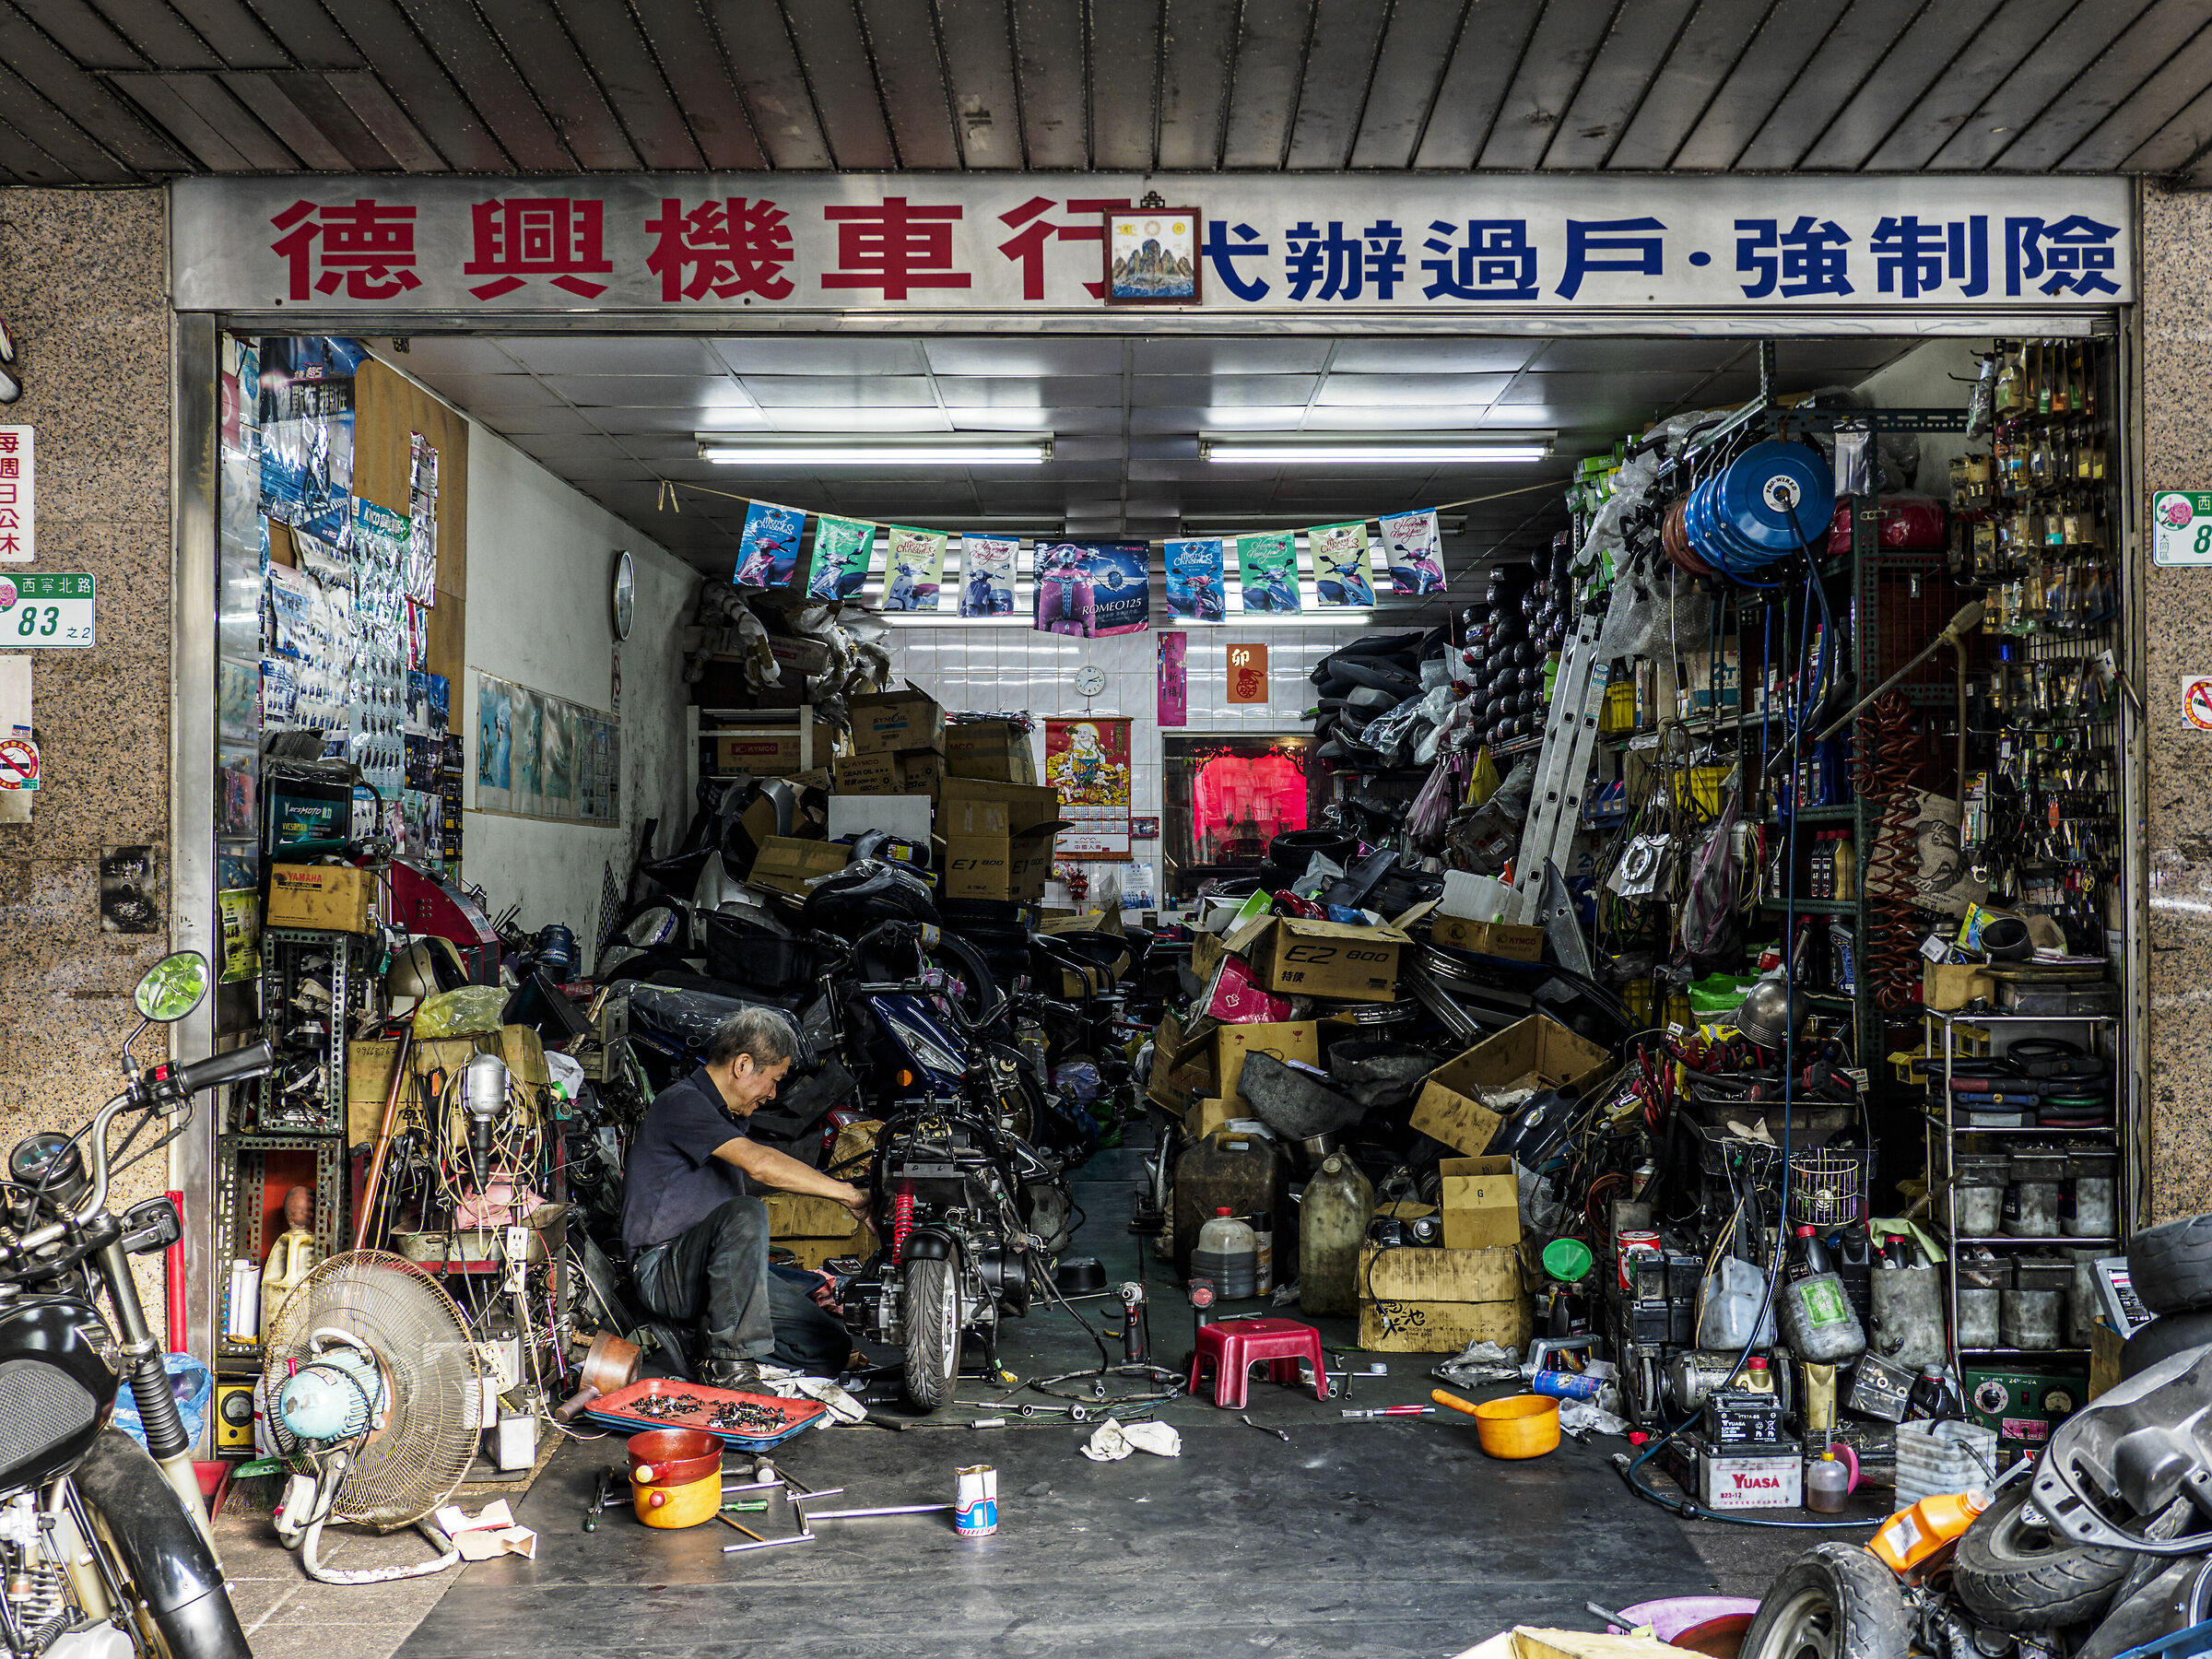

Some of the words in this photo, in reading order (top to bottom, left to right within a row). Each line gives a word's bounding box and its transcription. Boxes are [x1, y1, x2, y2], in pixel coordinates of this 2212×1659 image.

[270, 196, 1130, 302] 德興機車行
[755, 520, 794, 535] Christmas
[762, 516, 786, 529] Merry
[896, 544, 936, 557] Christmas
[903, 541, 929, 550] Merry
[1173, 554, 1213, 567] Christmas
[22, 578, 90, 594] 西寧北路
[1082, 597, 1142, 616] ROMEO125
[18, 606, 59, 636] 83
[1231, 648, 1250, 666] 卯
[747, 745, 777, 753] KYMCO
[951, 859, 978, 870] E1
[288, 872, 323, 882] YAMAHA
[1445, 939, 1467, 949] KYMCO
[1509, 936, 1536, 946] KYMCO
[1346, 950, 1389, 962] 800
[1732, 1474, 1780, 1488] YUASA
